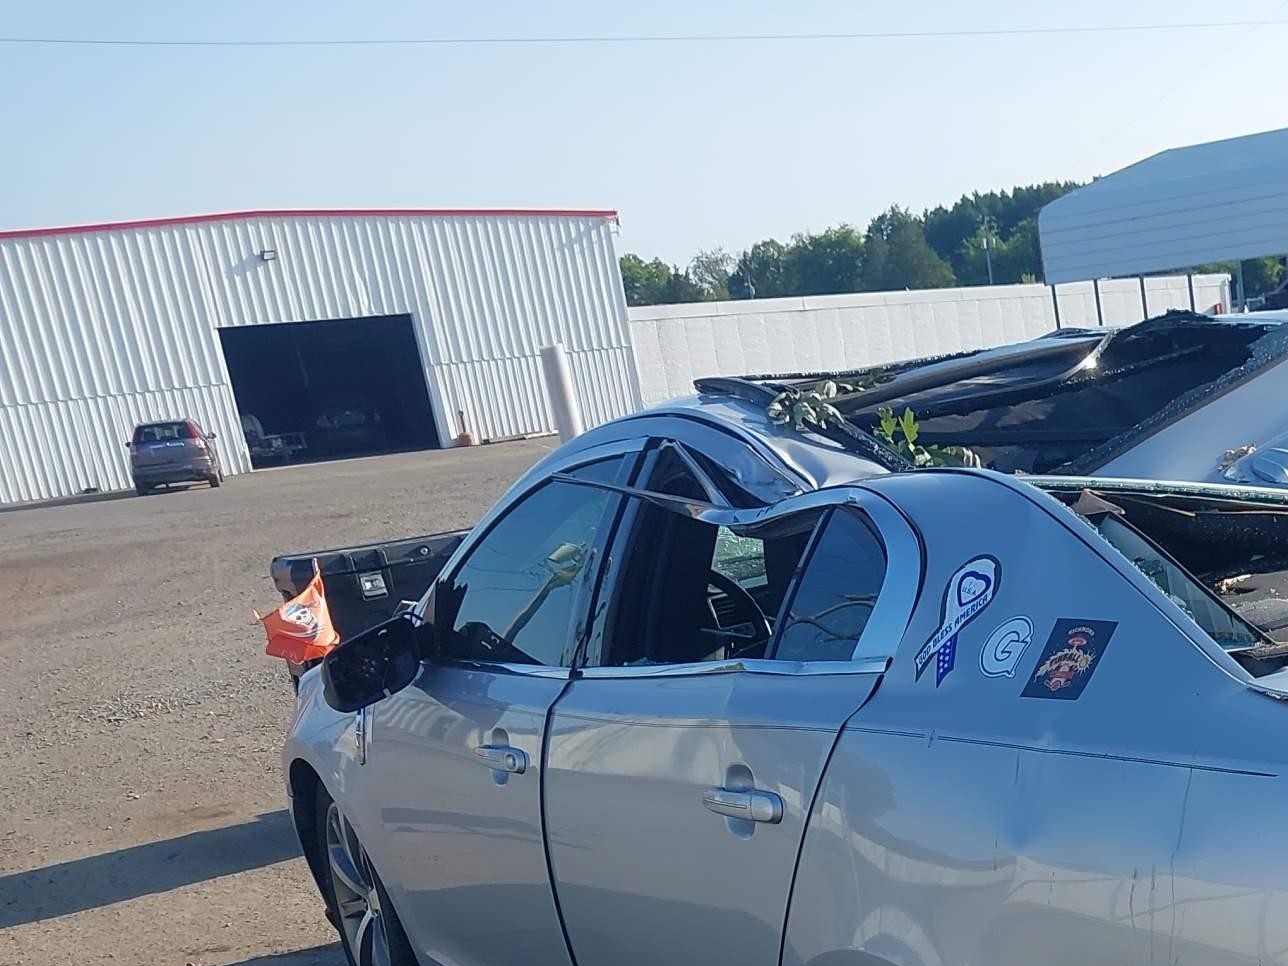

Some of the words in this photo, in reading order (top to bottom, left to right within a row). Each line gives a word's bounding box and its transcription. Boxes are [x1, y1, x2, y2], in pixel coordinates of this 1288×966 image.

[918, 645, 931, 664] GOD
[932, 622, 953, 648] BLESS
[954, 593, 989, 628] AMERICA
[979, 616, 1034, 678] G
